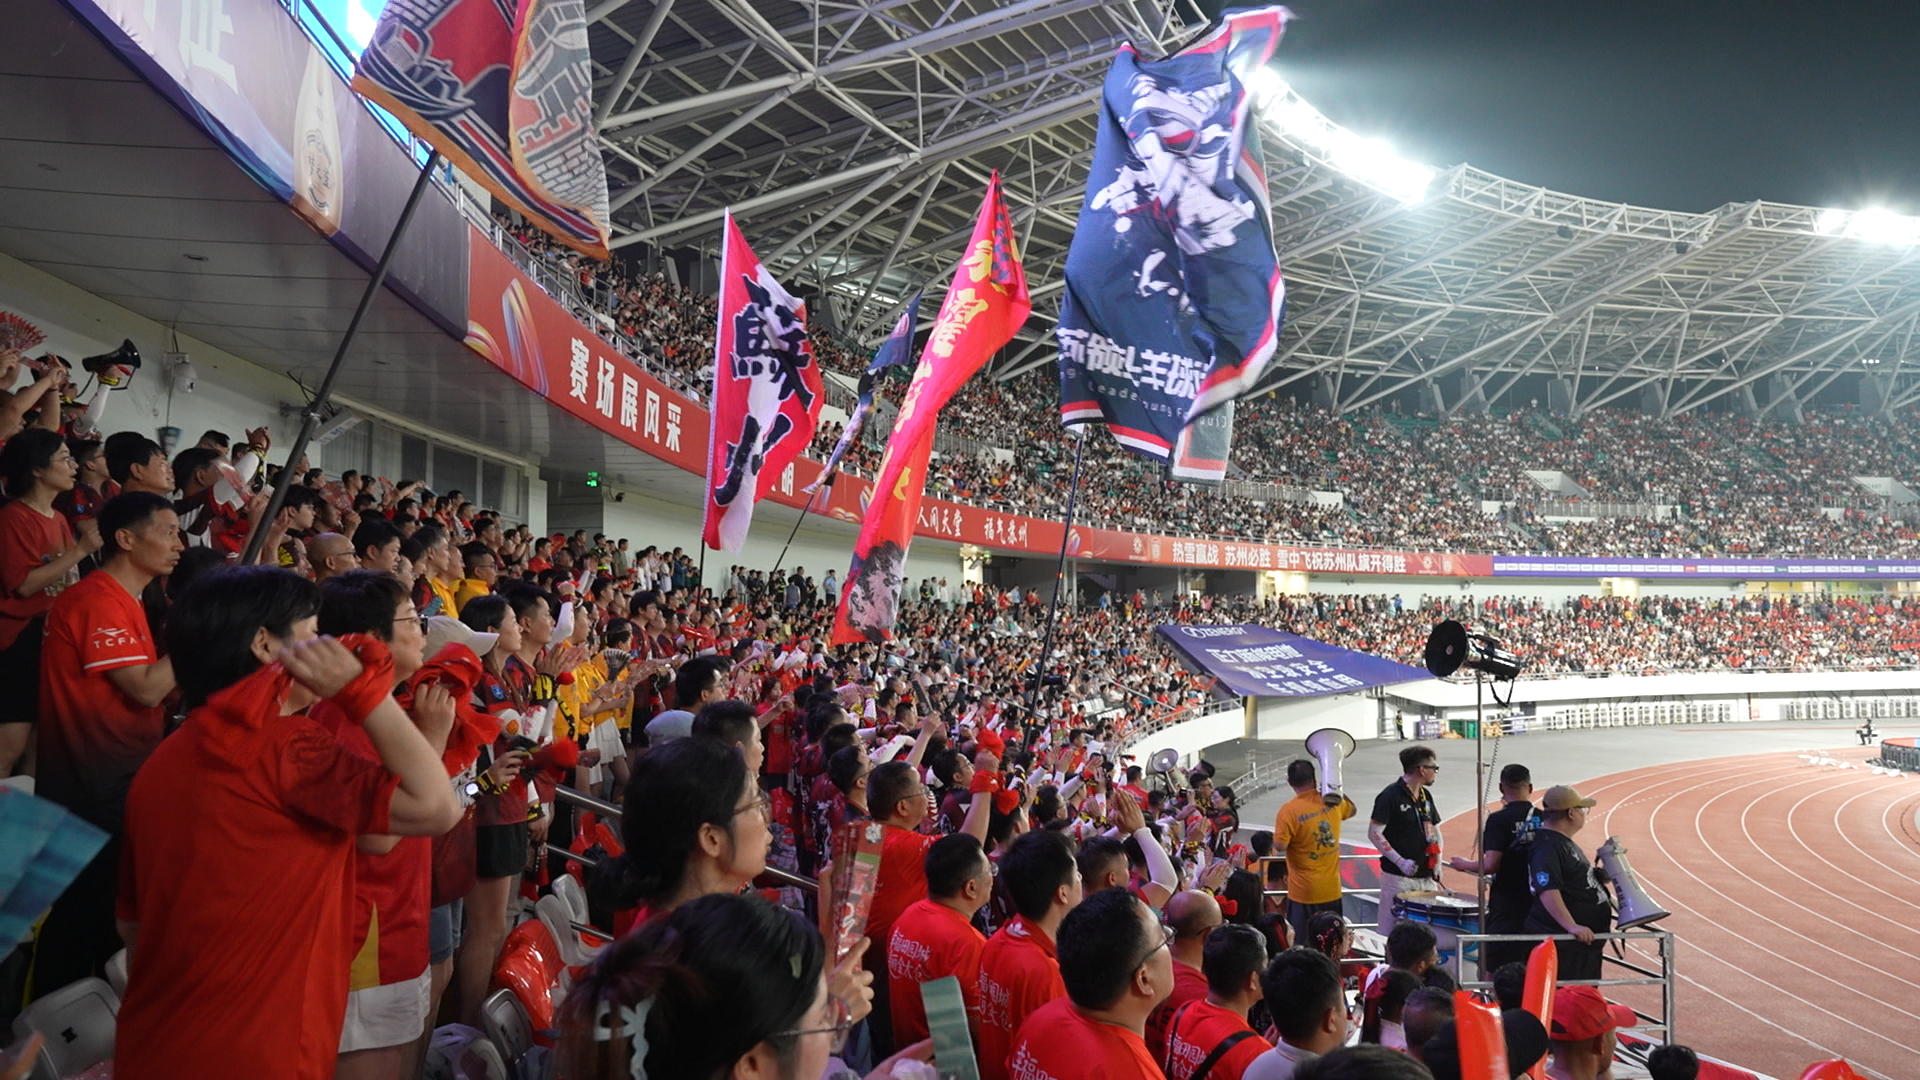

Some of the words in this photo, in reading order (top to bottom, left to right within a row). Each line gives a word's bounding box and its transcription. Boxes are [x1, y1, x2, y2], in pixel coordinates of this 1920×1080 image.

[569, 337, 682, 453] 赛场展风采
[916, 505, 963, 537] 人间天堂
[1172, 541, 1219, 565] 热雪赢战
[1224, 544, 1271, 568] 苏州必胜
[1276, 551, 1406, 573] 雪中飞祝苏州队旗开得胜
